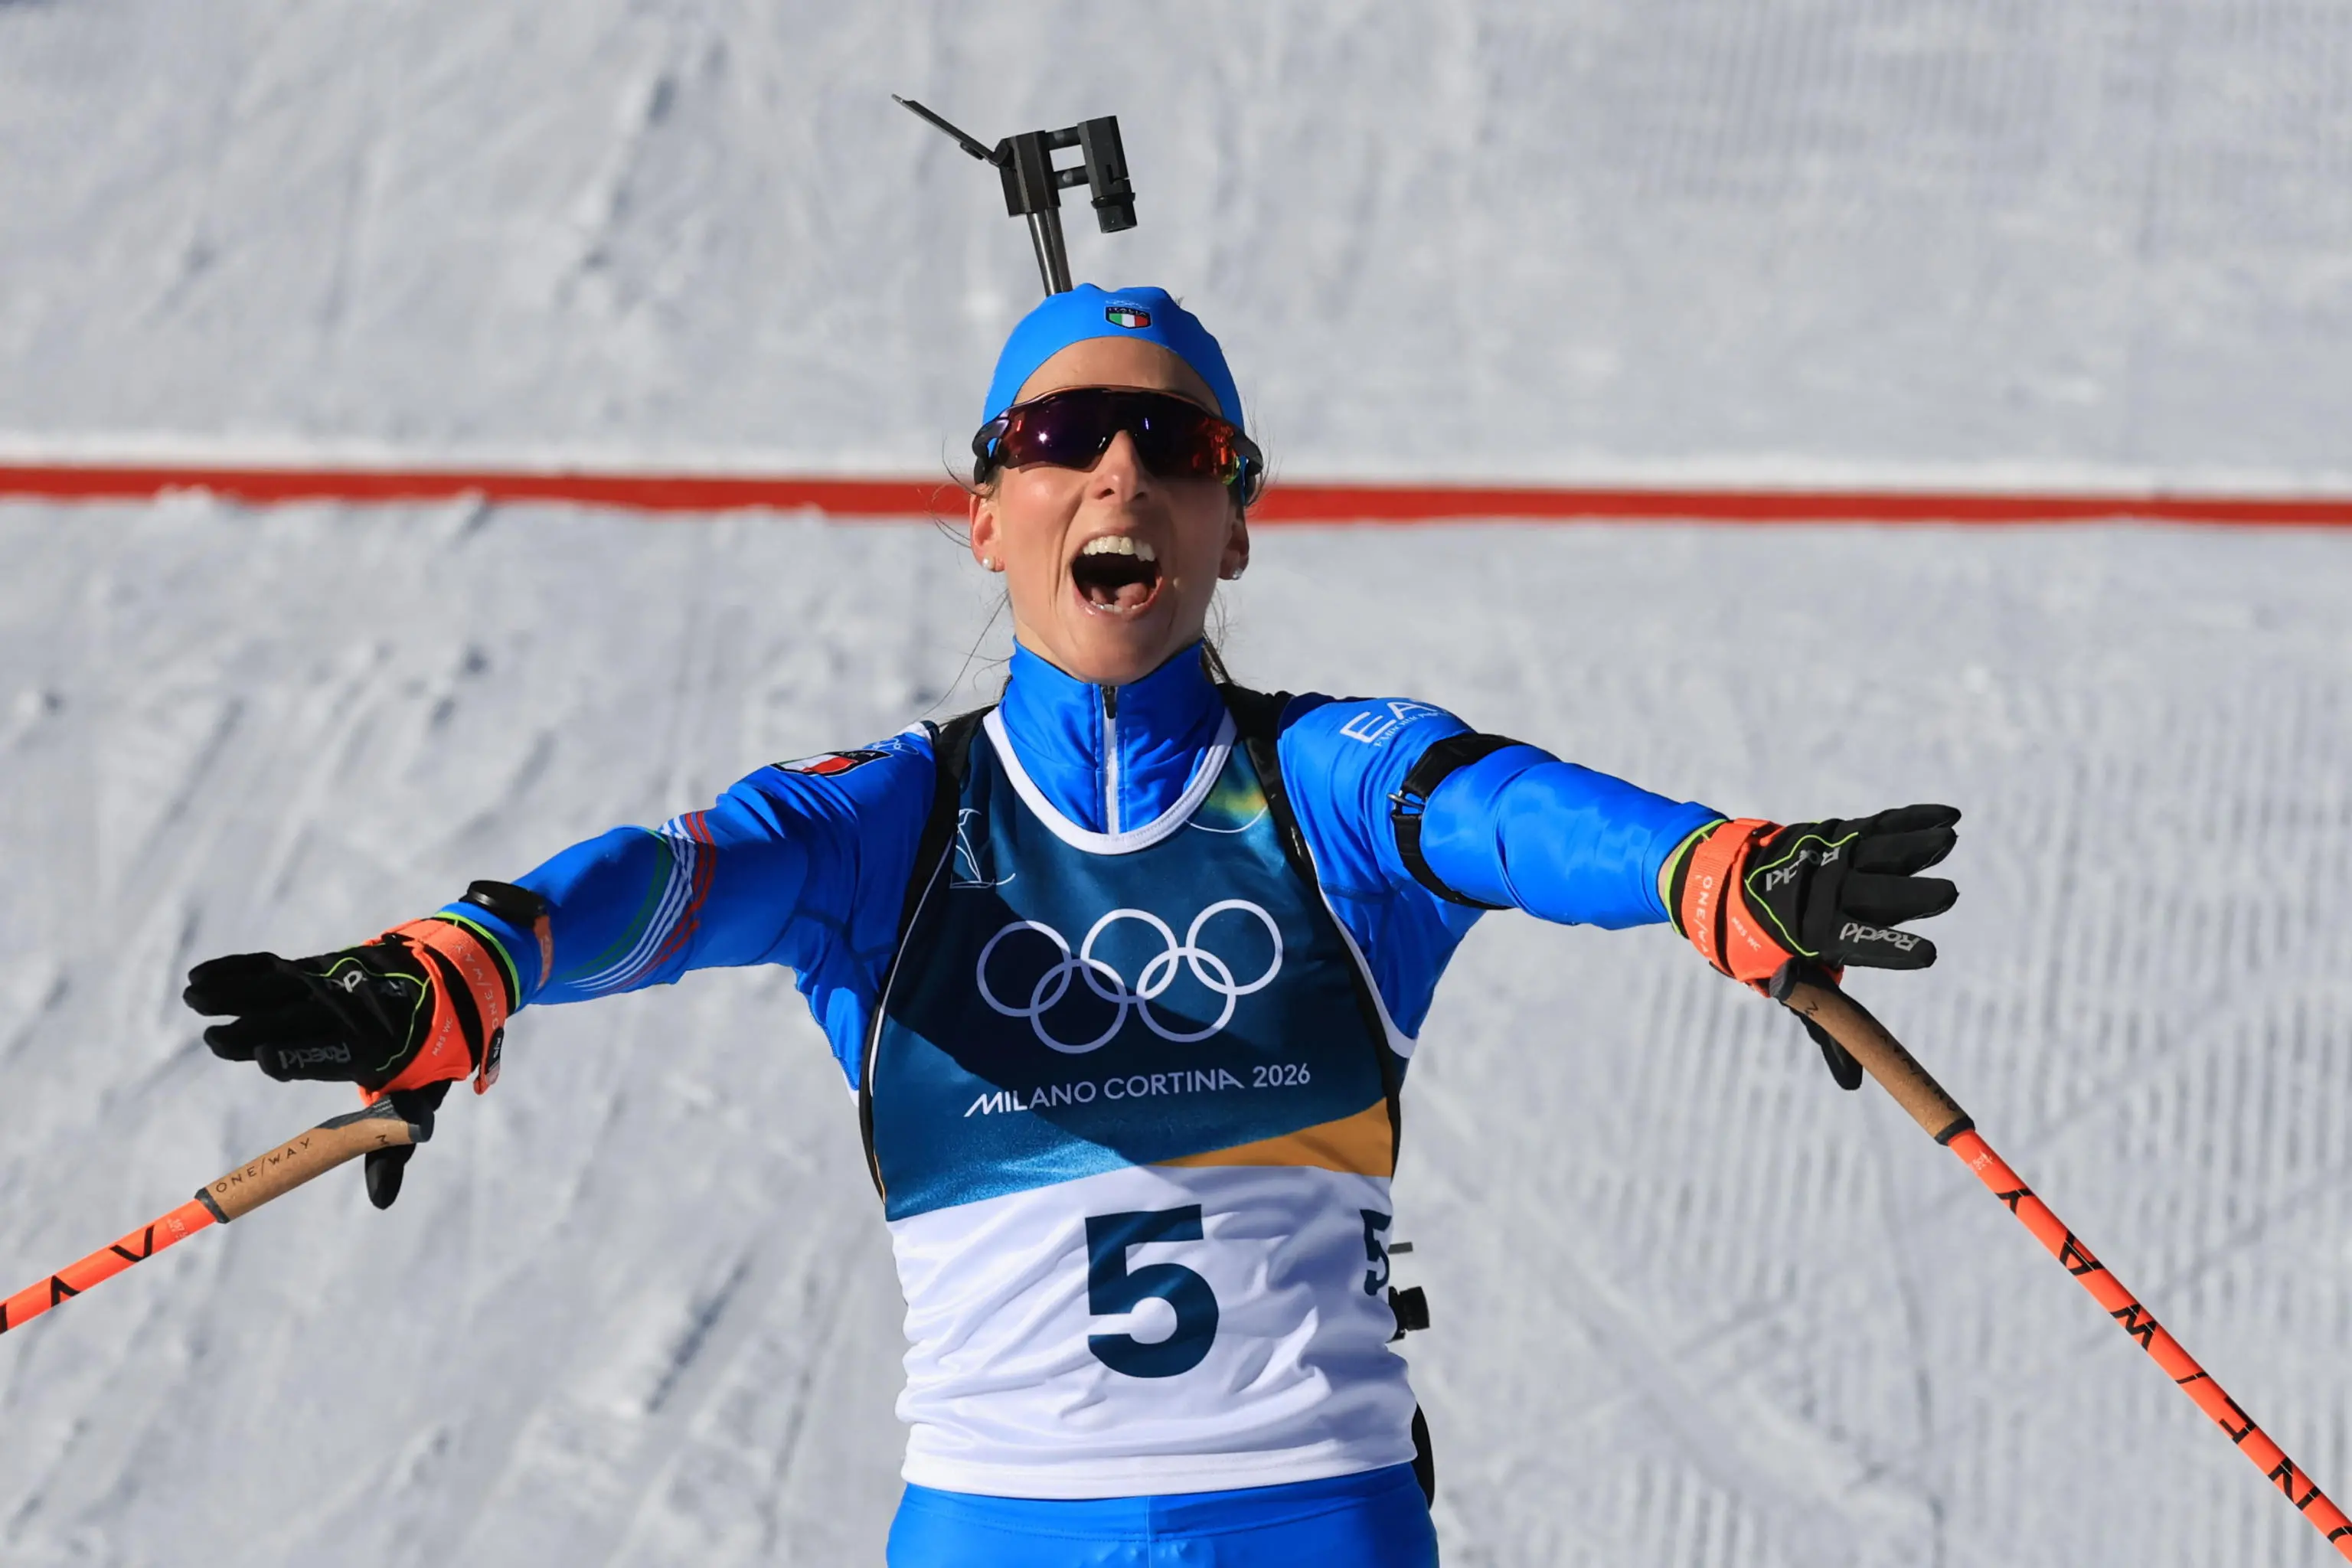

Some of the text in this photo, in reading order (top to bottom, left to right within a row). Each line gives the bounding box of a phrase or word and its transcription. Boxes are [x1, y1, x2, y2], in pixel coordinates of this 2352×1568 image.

[1838, 922, 1921, 952] Roeckl
[963, 1063, 1311, 1118] MILANO CORTINA 2026
[214, 1137, 312, 1194] ONE/WAY
[1359, 1209, 1393, 1296] 5
[1085, 1204, 1220, 1378] 5
